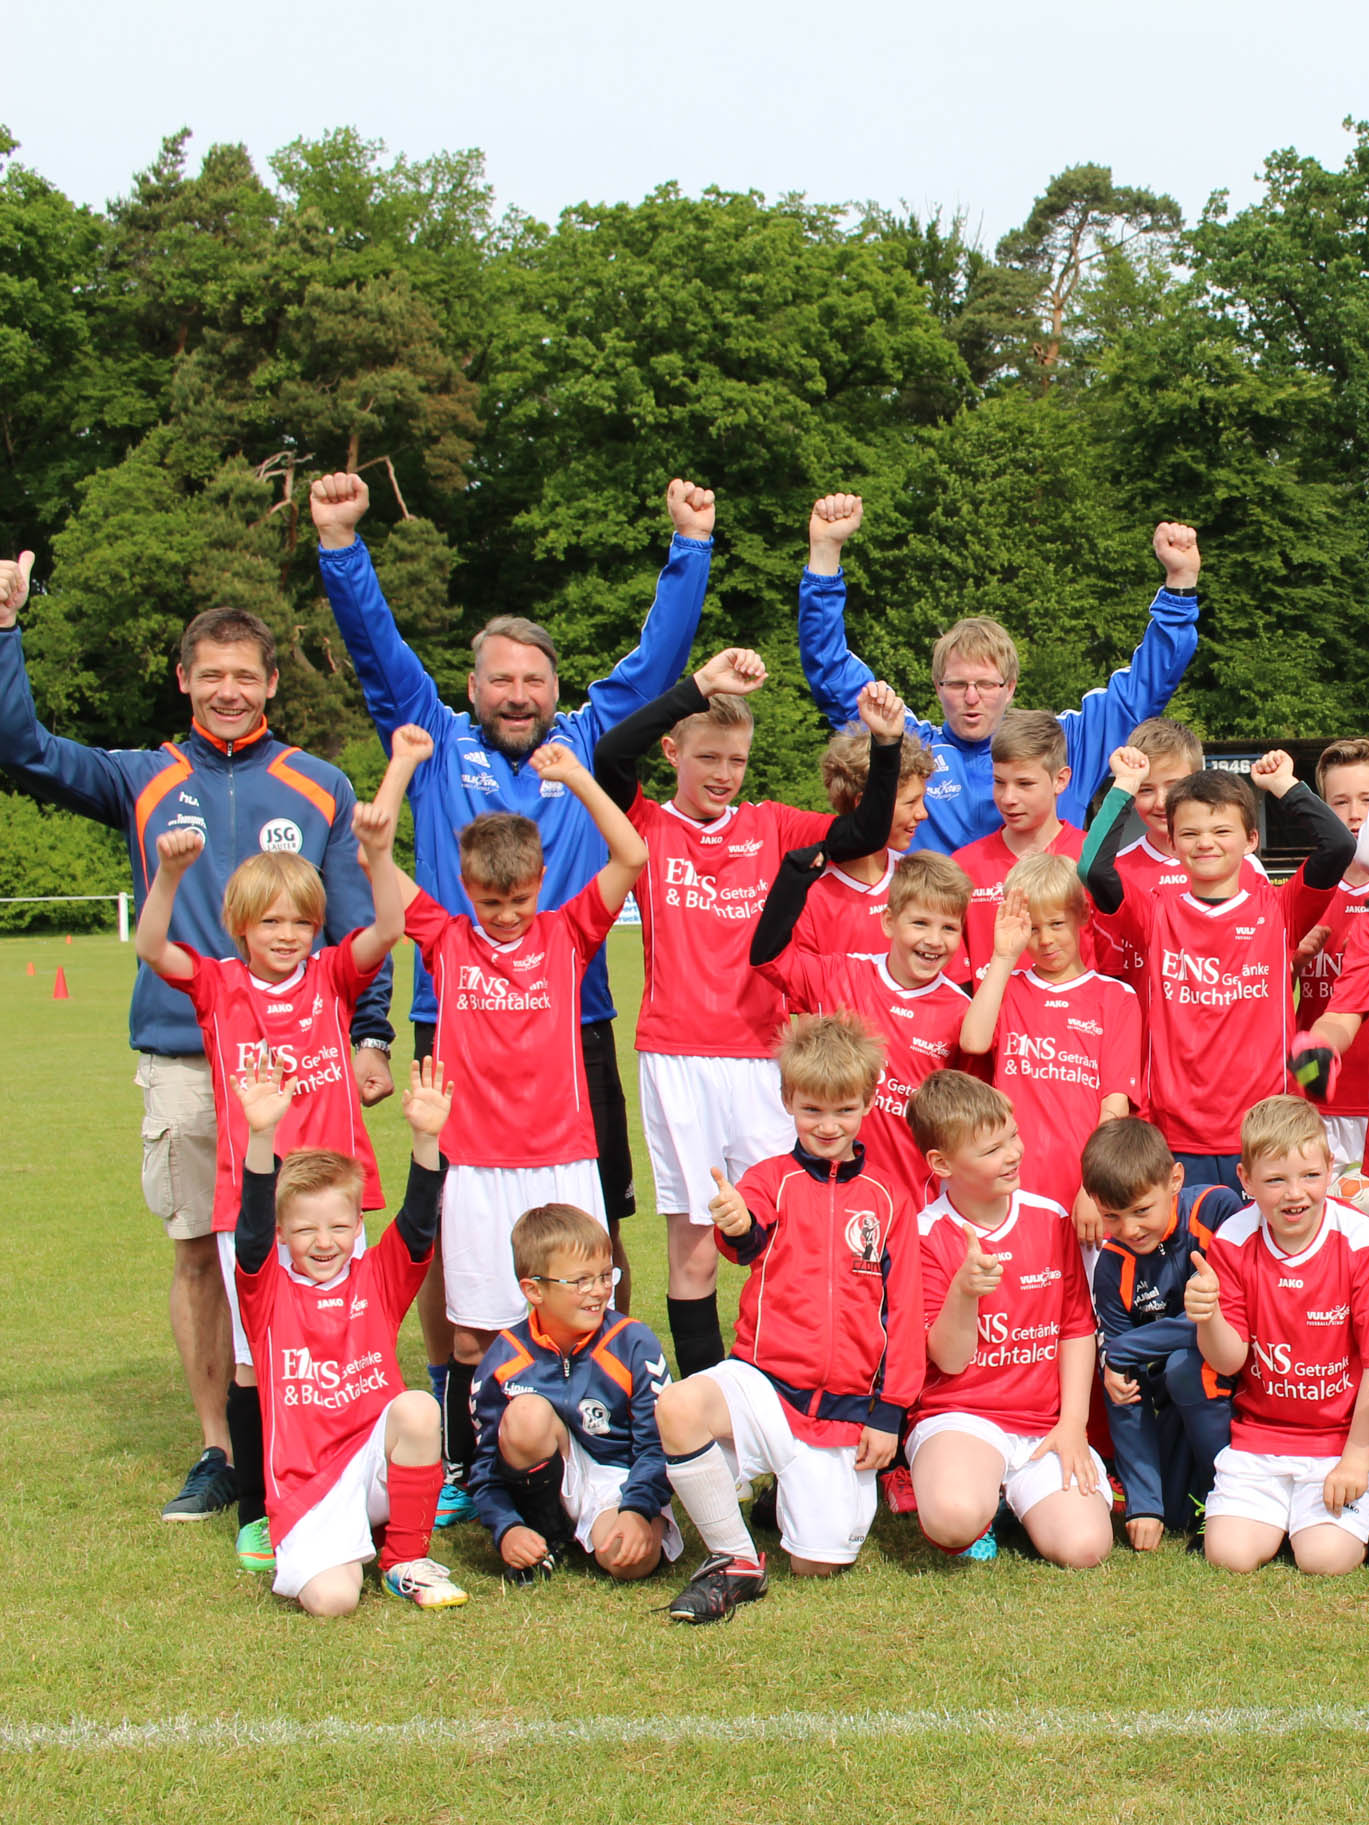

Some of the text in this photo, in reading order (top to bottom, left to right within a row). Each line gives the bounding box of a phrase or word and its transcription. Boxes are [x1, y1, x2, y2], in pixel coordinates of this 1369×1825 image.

[266, 827, 294, 843] JSG
[700, 836, 724, 845] JAKO
[1158, 874, 1188, 885] JAKO
[665, 888, 681, 907] &
[1163, 980, 1173, 1001] &
[266, 1003, 293, 1014] JAKO
[456, 992, 552, 1011] & Buchtaleck
[1044, 1000, 1069, 1009] JAKO
[890, 1005, 915, 1019] JAKO
[1004, 1059, 1018, 1075] &
[1277, 1278, 1304, 1289] JAKO
[317, 1297, 344, 1310] JAKO
[284, 1384, 299, 1407] &
